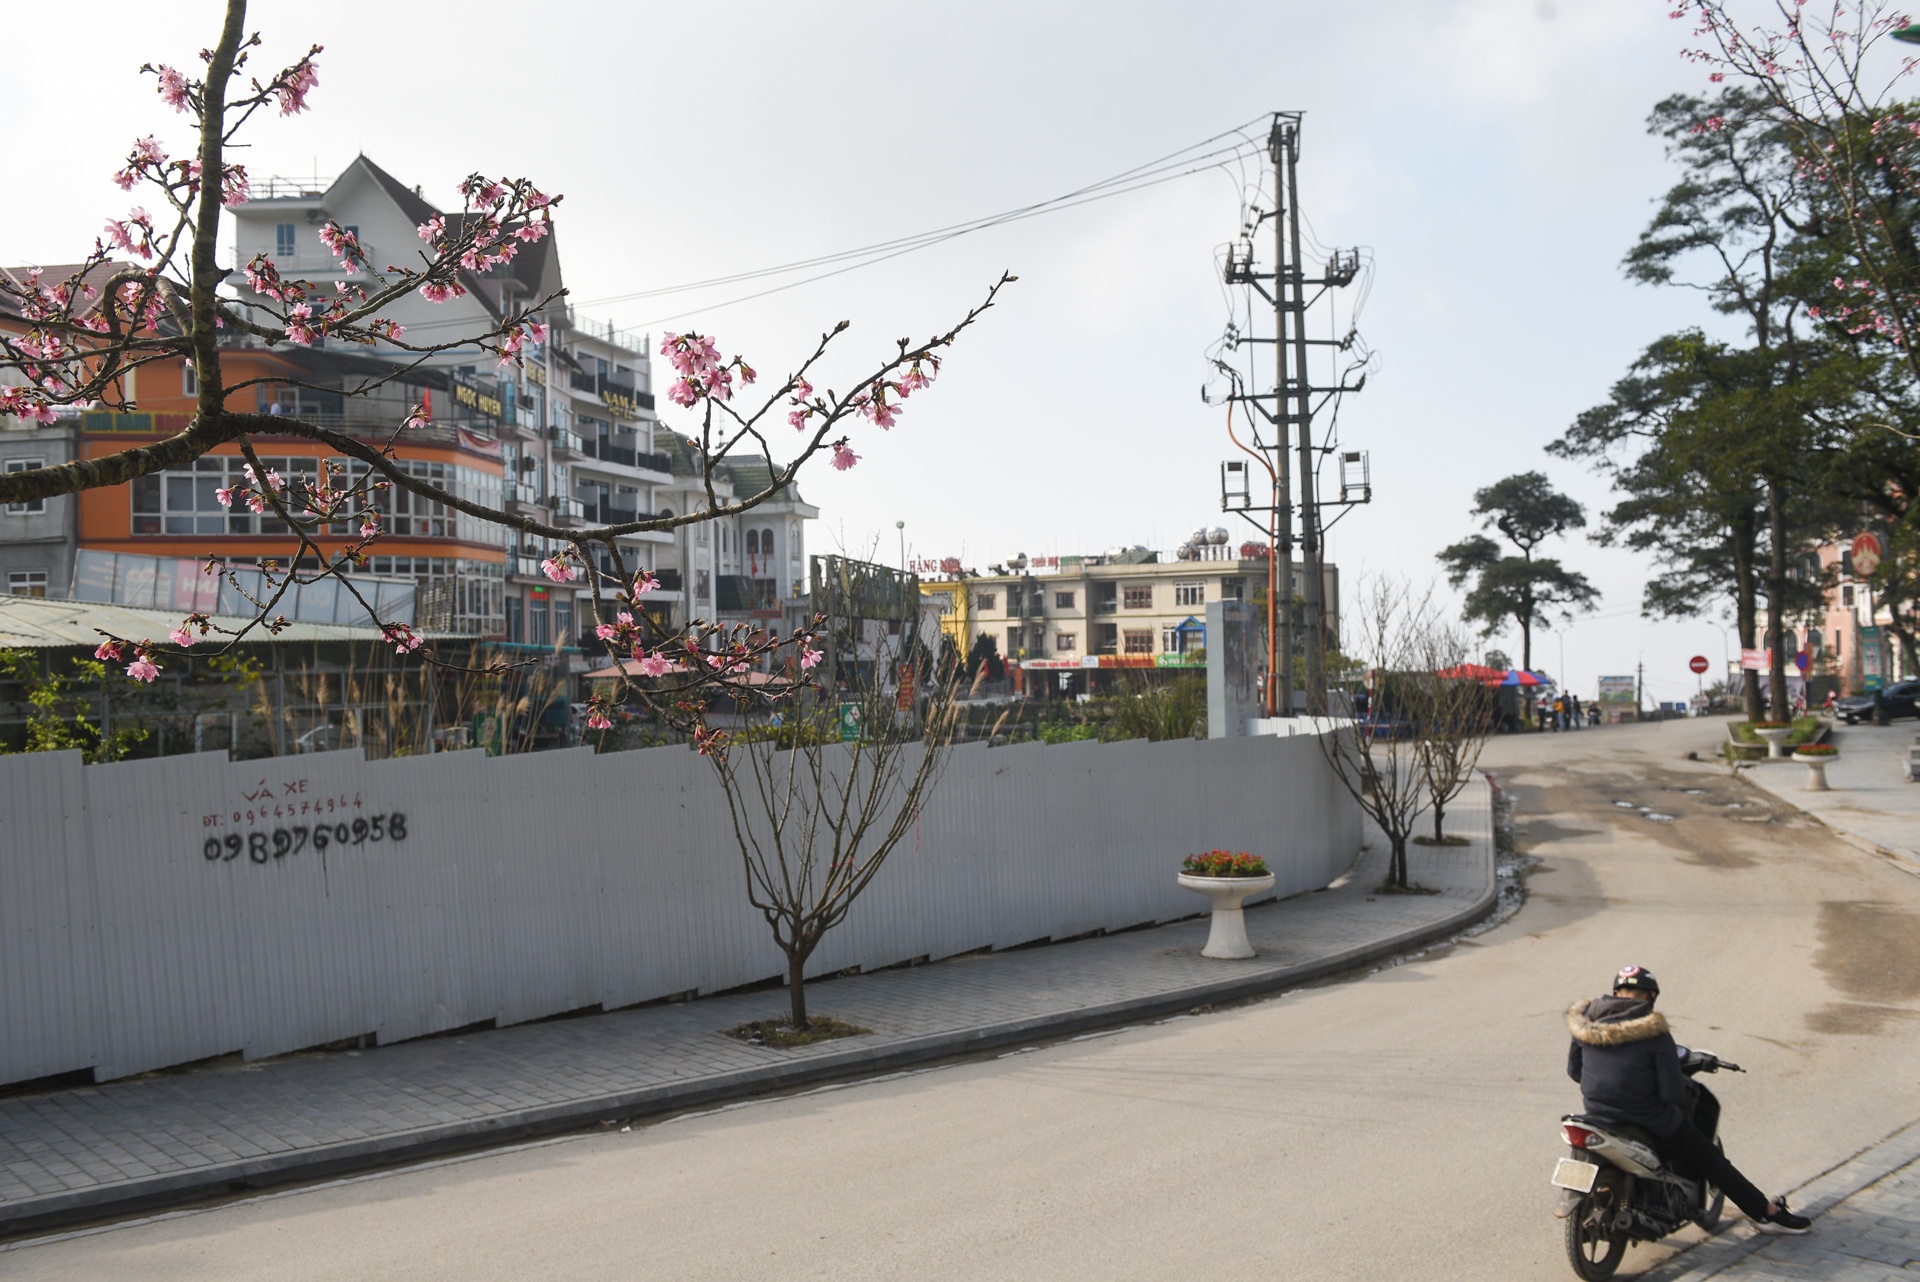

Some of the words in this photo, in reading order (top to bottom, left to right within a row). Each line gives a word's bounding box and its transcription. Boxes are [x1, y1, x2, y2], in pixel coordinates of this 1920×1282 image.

[609, 406, 633, 419] HOTEL
[241, 779, 273, 801] VÁ
[283, 779, 308, 794] XE
[204, 812, 407, 863] 0989760958
